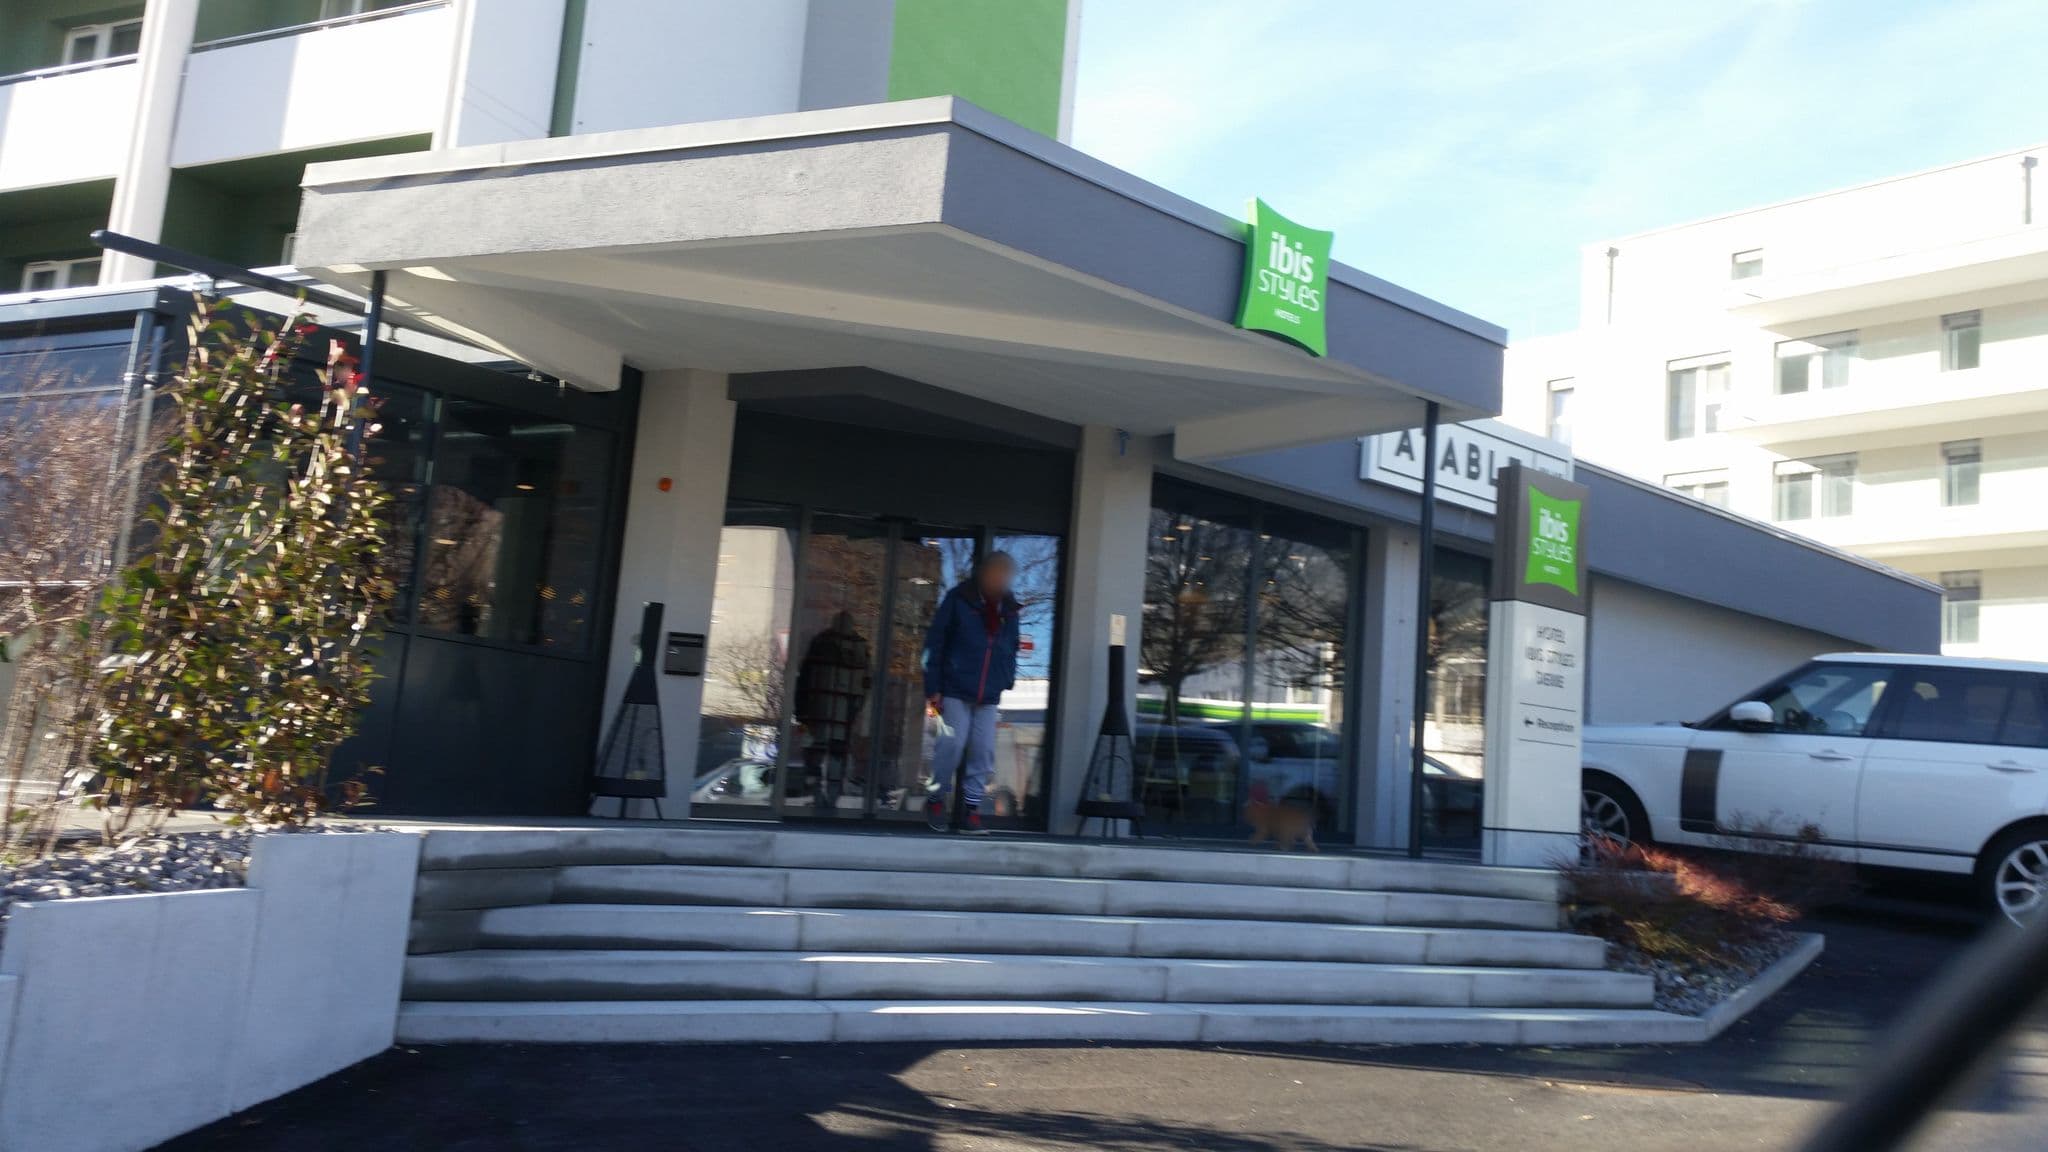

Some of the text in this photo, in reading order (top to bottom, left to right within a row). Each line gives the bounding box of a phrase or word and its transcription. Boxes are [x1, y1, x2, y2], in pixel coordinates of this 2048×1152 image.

[1269, 231, 1314, 284] ibis
[1394, 429, 1415, 462] A
[1539, 507, 1569, 543] ibis
